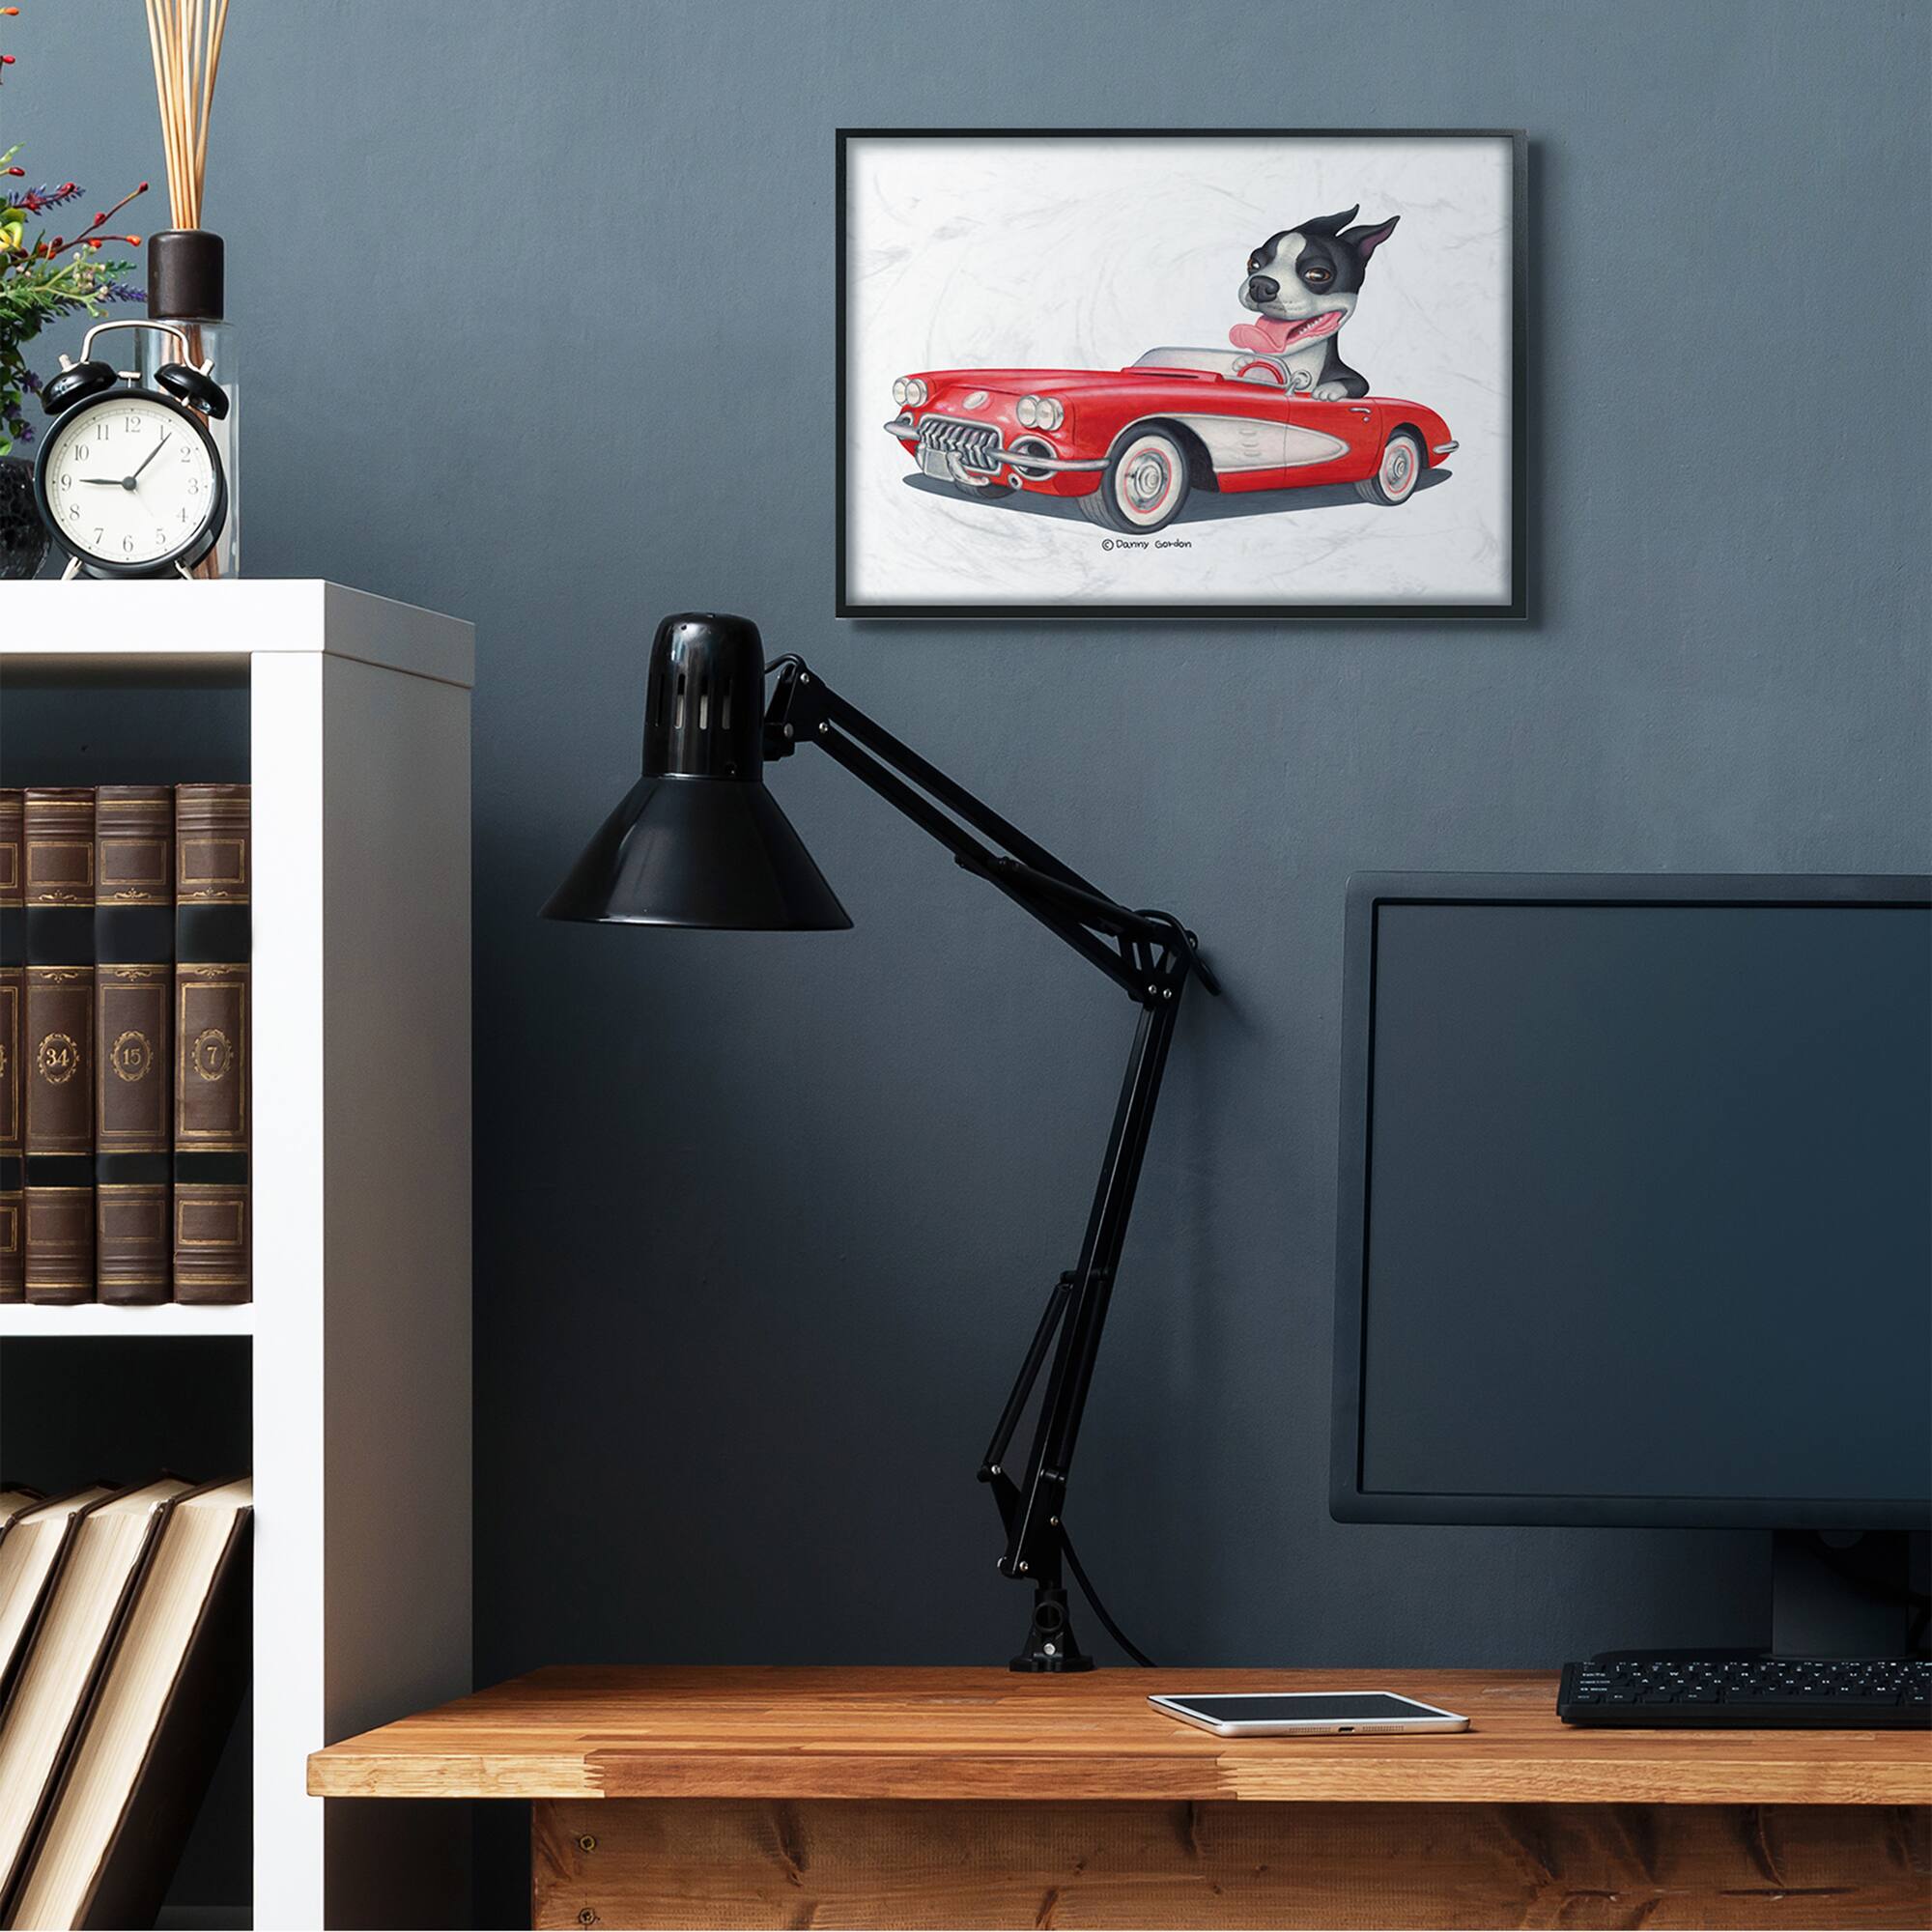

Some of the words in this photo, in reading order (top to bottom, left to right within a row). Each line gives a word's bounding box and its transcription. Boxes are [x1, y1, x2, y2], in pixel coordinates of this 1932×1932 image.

[97, 424, 109, 440] 11
[126, 416, 141, 433] 12
[74, 445, 90, 461] 10
[181, 447, 191, 463] 2
[61, 474, 71, 492] 9
[187, 478, 199, 495] 3
[70, 503, 80, 521] 8
[177, 507, 188, 523] 4
[94, 527, 104, 545] 7
[123, 535, 133, 553] 6
[156, 528, 166, 545] 5
[1155, 538, 1192, 549] Gordon
[46, 1049, 70, 1066] 34
[123, 1049, 141, 1065] 15
[207, 1047, 217, 1065] 7
